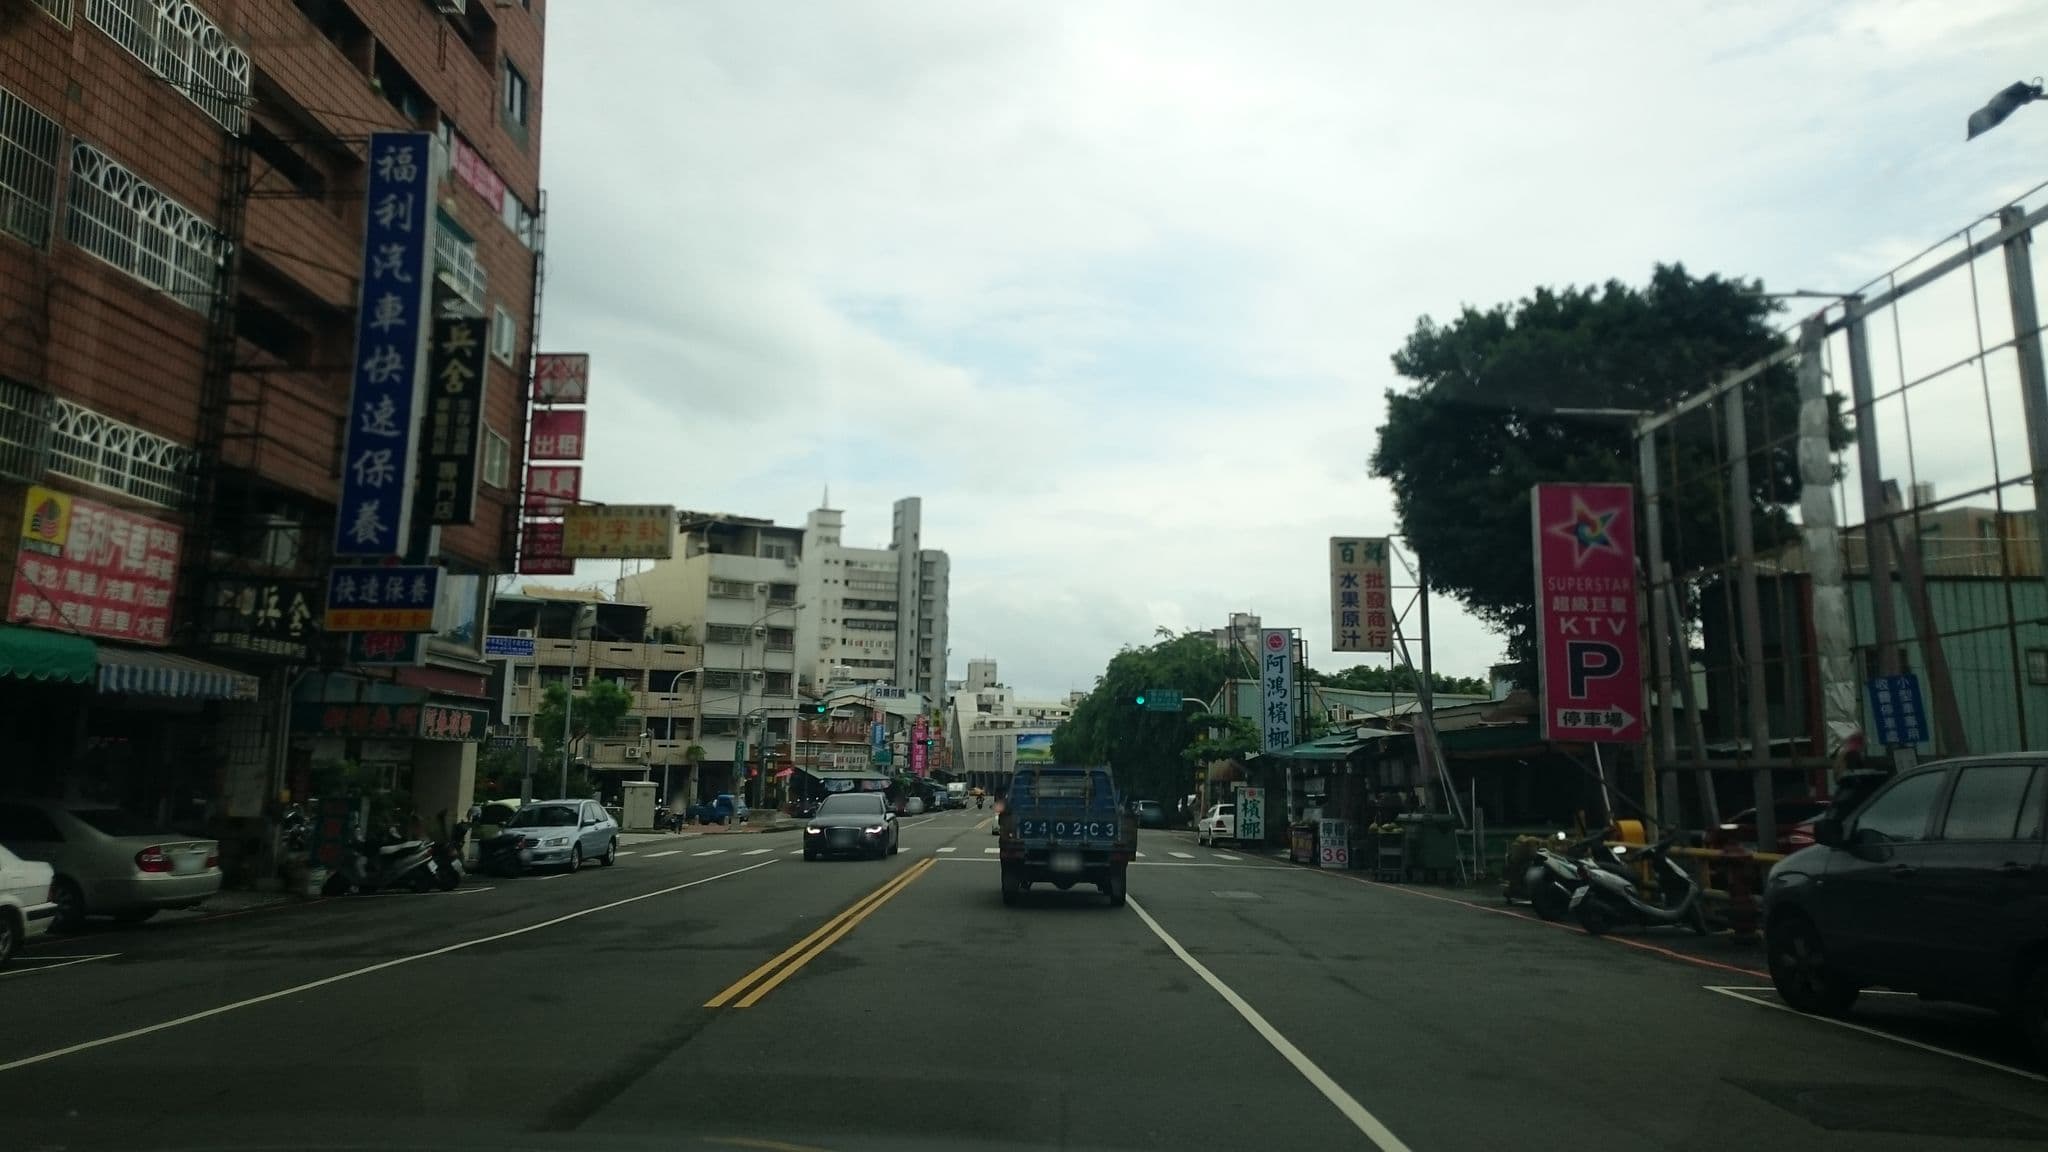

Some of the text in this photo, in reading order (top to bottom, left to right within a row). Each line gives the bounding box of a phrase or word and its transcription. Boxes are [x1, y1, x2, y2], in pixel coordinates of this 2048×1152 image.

[347, 145, 418, 544] 福利汽車快速保養
[534, 434, 579, 455] 出租
[335, 574, 430, 603] 快速保養
[1547, 576, 1632, 592] SUPERSTAR
[1339, 571, 1361, 648] 水果原汁
[1364, 572, 1388, 649] 批發商行
[1559, 615, 1628, 636] KTV
[1566, 640, 1624, 699] P
[1265, 651, 1290, 751] 阿鴻檳榔
[1562, 710, 1625, 728] 停車場
[1239, 798, 1262, 841] 檳榔
[1322, 847, 1348, 863] 36
